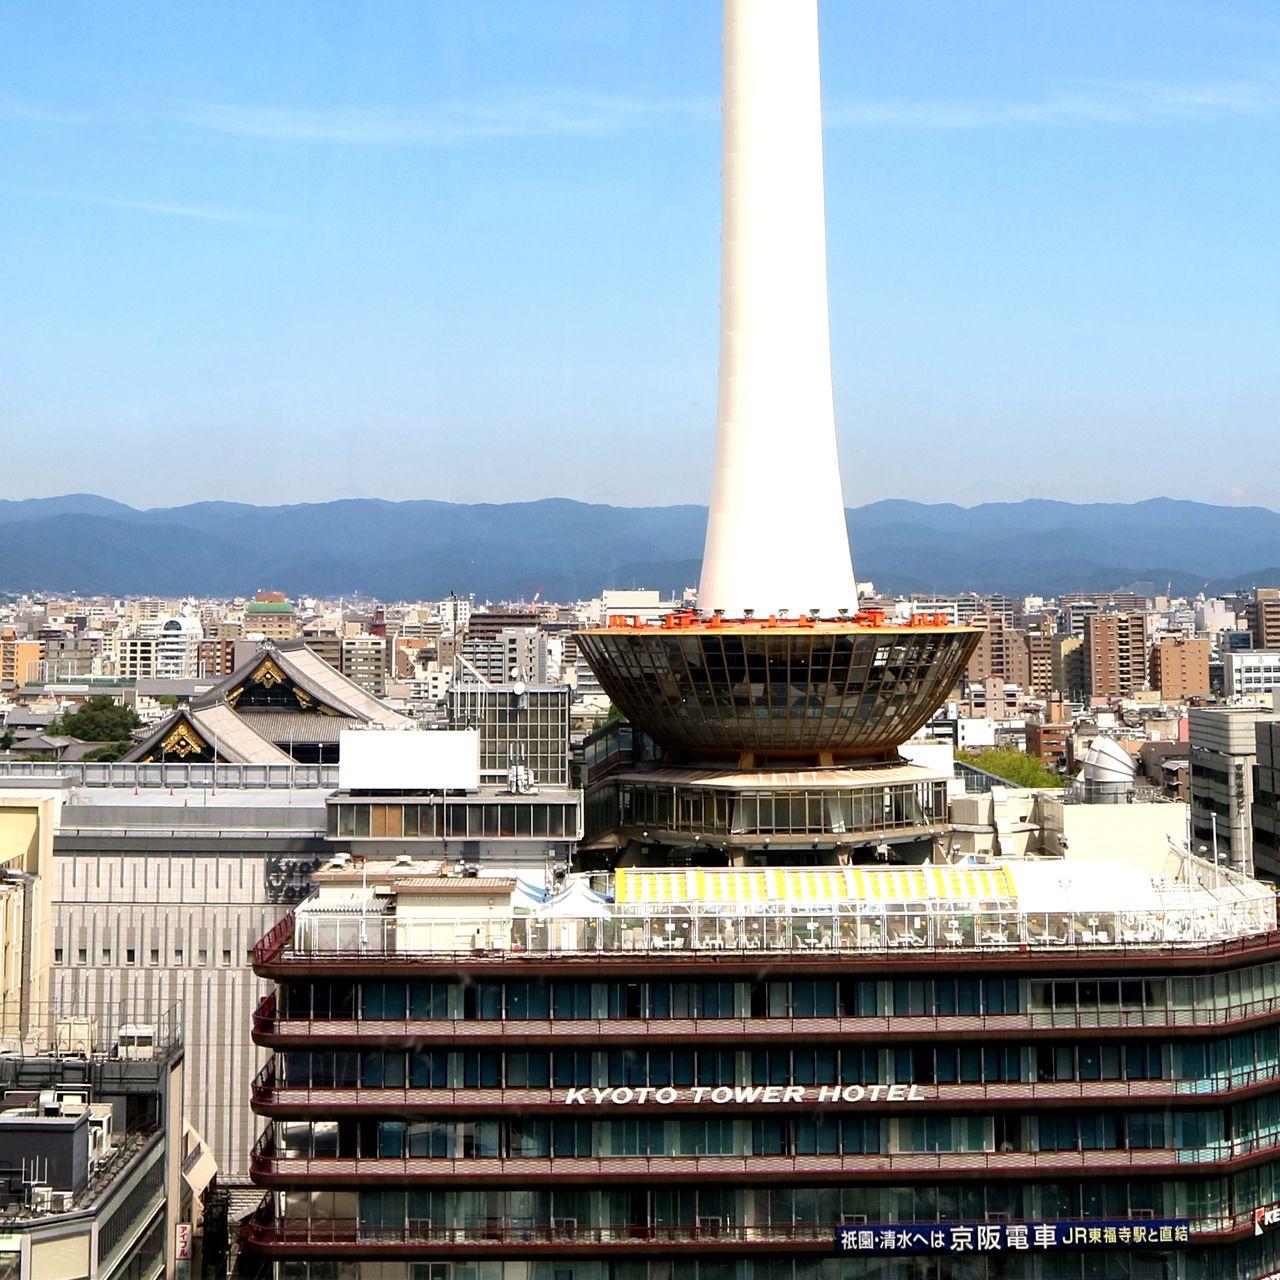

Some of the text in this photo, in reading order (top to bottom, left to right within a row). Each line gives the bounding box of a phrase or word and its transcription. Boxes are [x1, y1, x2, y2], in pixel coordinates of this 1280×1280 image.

[267, 857, 321, 878] Kyot
[565, 1084, 926, 1105] KYOTO TOWER HOTEL
[180, 1226, 188, 1257] アイフル
[949, 1223, 1058, 1252] 京阪電車
[1062, 1224, 1189, 1245] JR東福寺駅と直結
